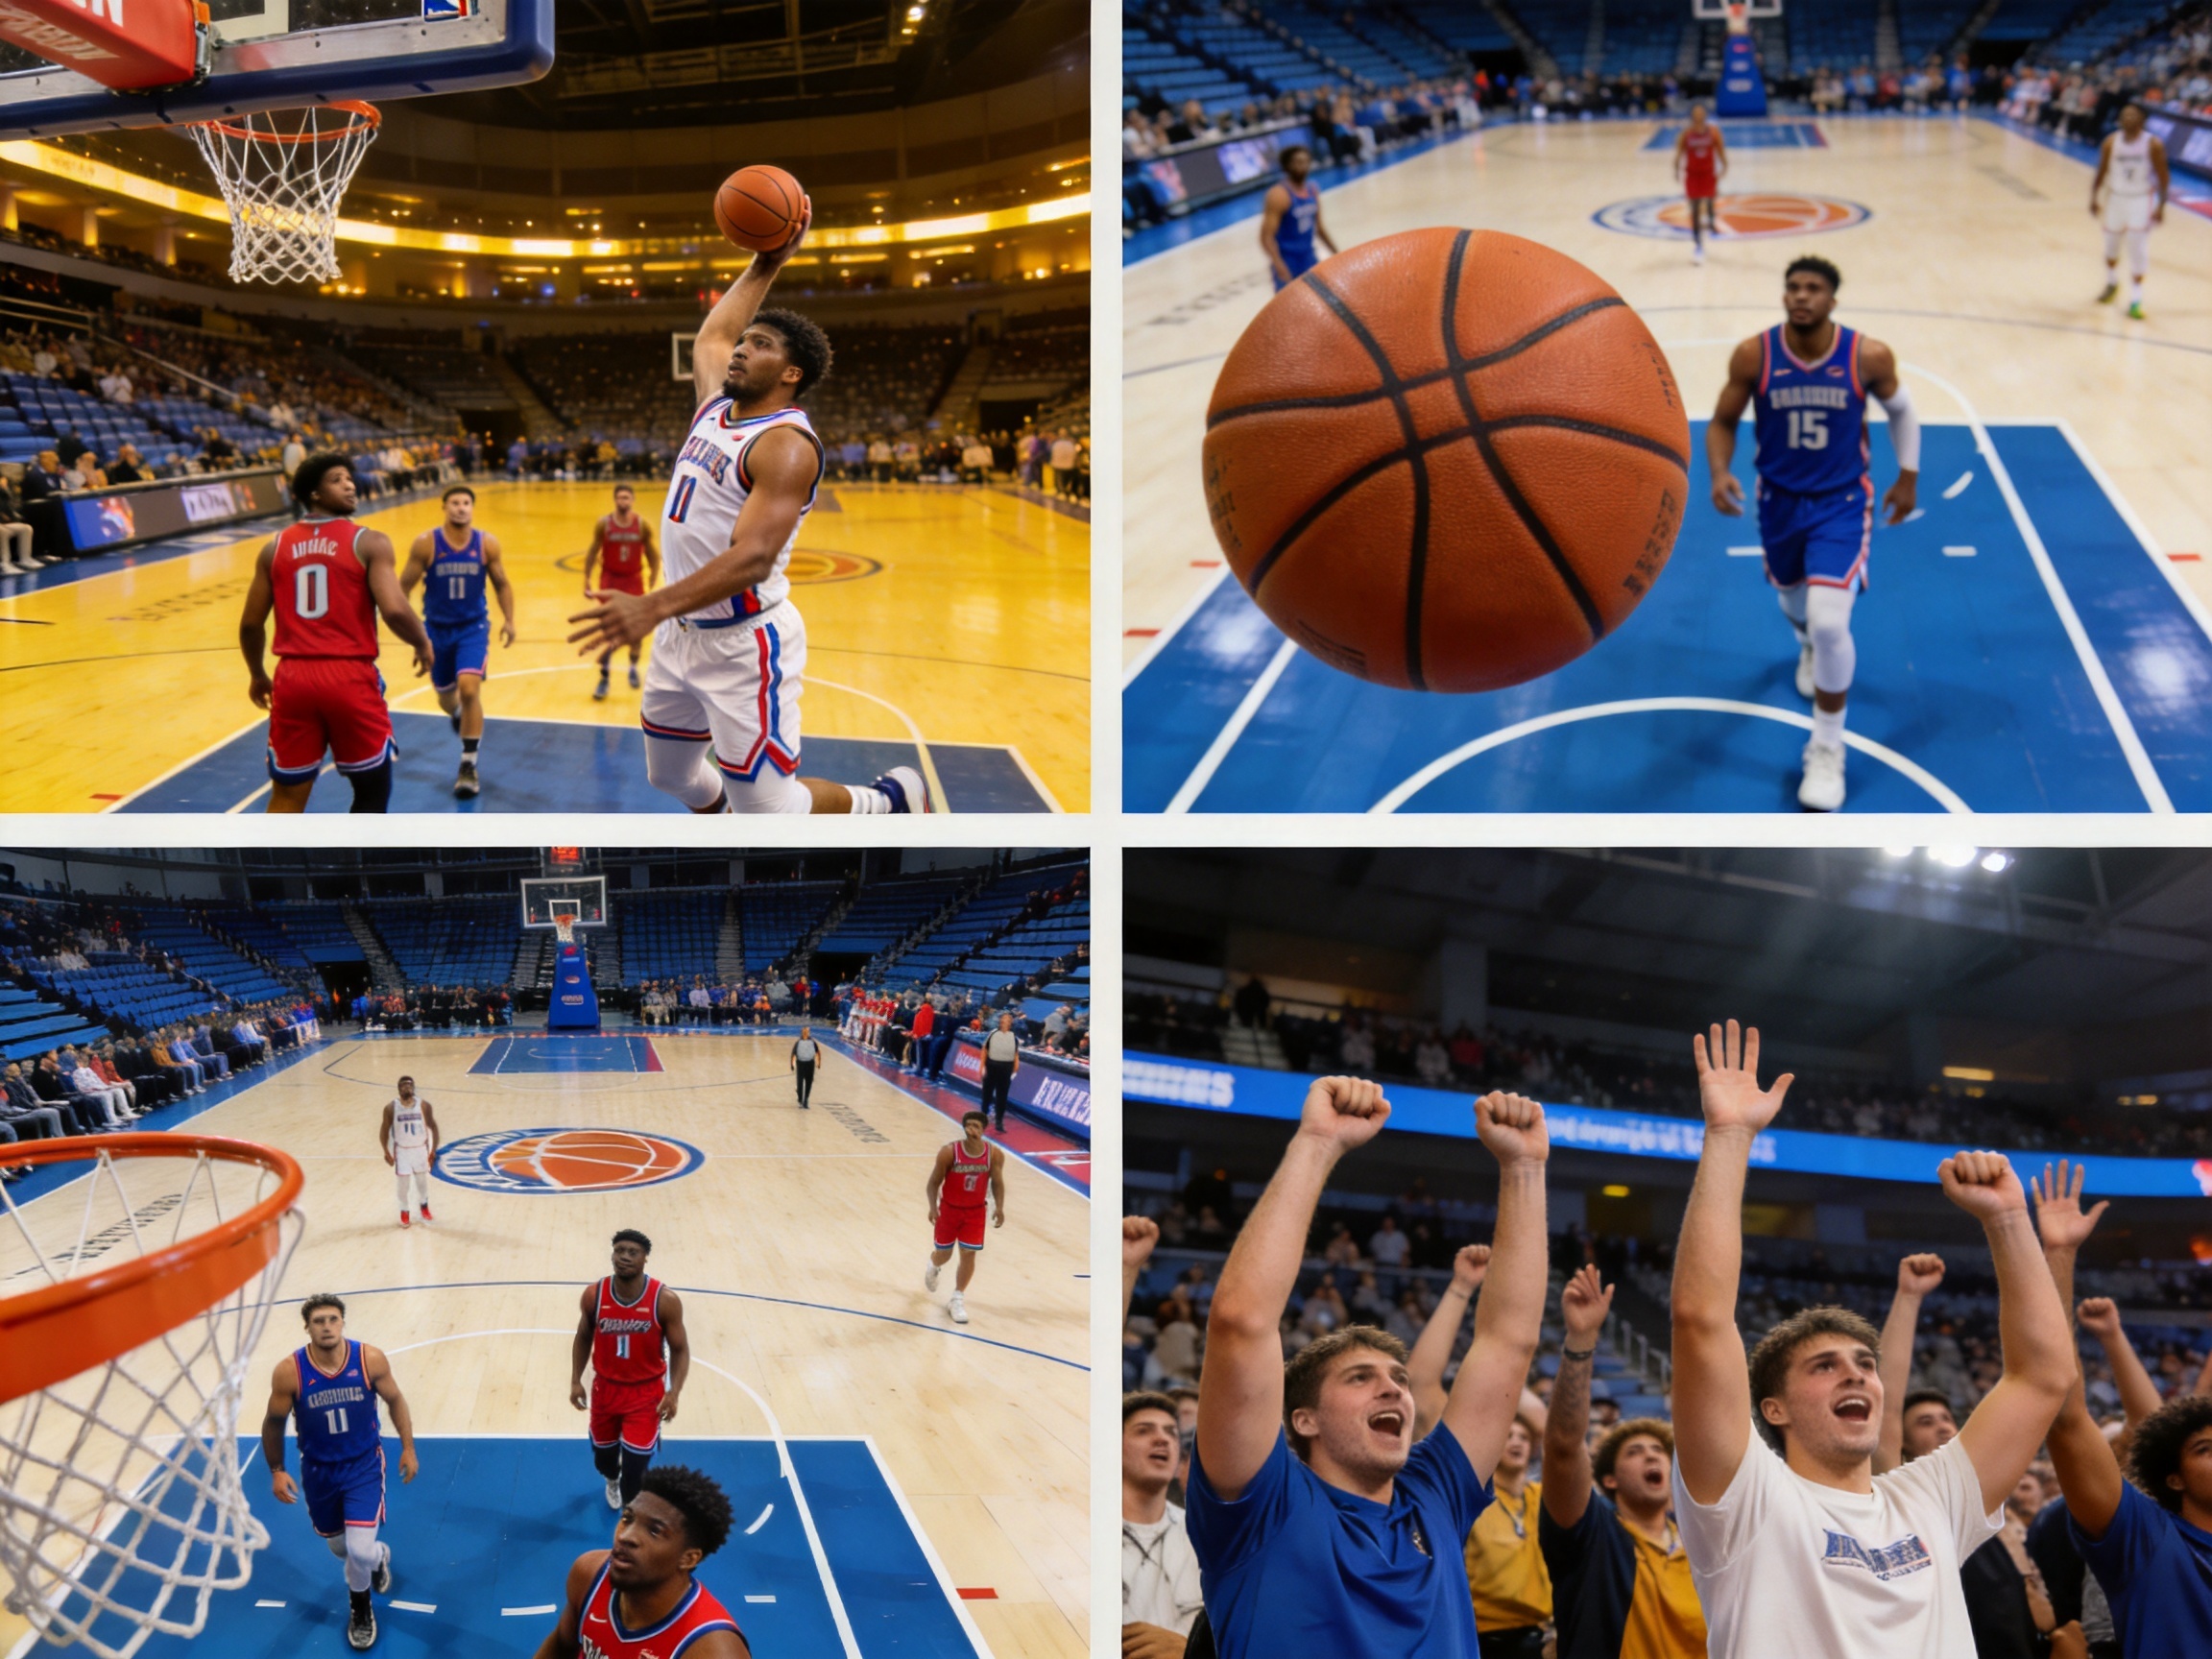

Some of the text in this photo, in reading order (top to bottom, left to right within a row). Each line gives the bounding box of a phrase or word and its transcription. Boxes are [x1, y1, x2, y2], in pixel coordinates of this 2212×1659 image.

[1788, 411, 1829, 450] 15
[296, 563, 329, 619] 0
[325, 1407, 349, 1434] 11
